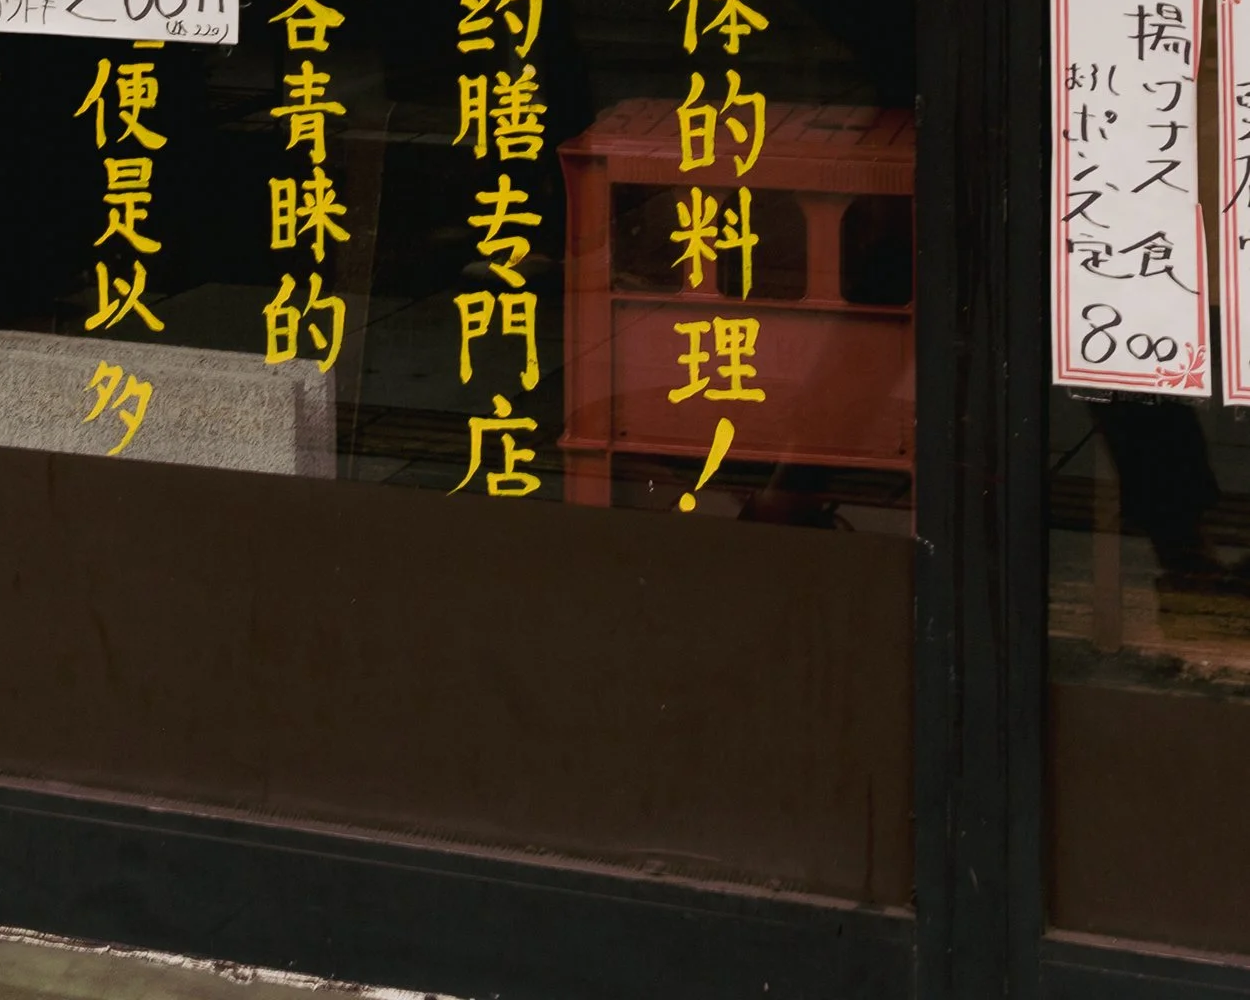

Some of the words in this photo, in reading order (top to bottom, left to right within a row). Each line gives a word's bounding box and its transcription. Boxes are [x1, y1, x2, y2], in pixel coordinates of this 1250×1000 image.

[74, 40, 168, 457] 便是以多
[1080, 302, 1178, 364] 800
